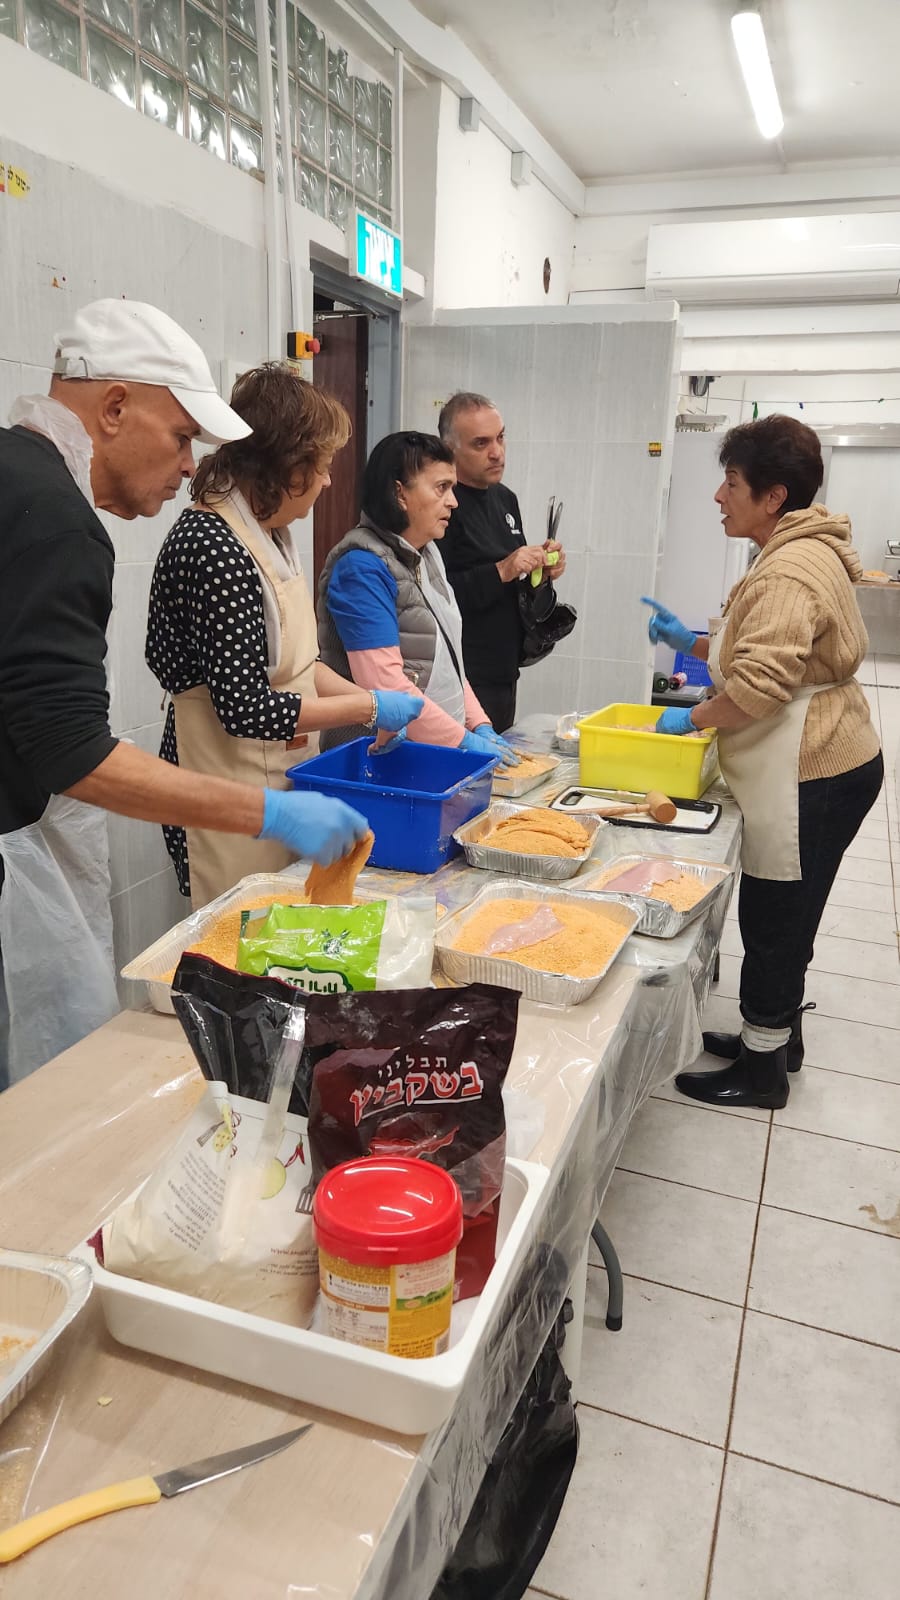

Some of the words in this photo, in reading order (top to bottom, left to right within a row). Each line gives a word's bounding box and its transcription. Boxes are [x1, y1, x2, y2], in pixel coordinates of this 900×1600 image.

[309, 981, 337, 993] וריח
[378, 1054, 447, 1078] תבליני
[349, 1060, 484, 1127] בשקביץ
